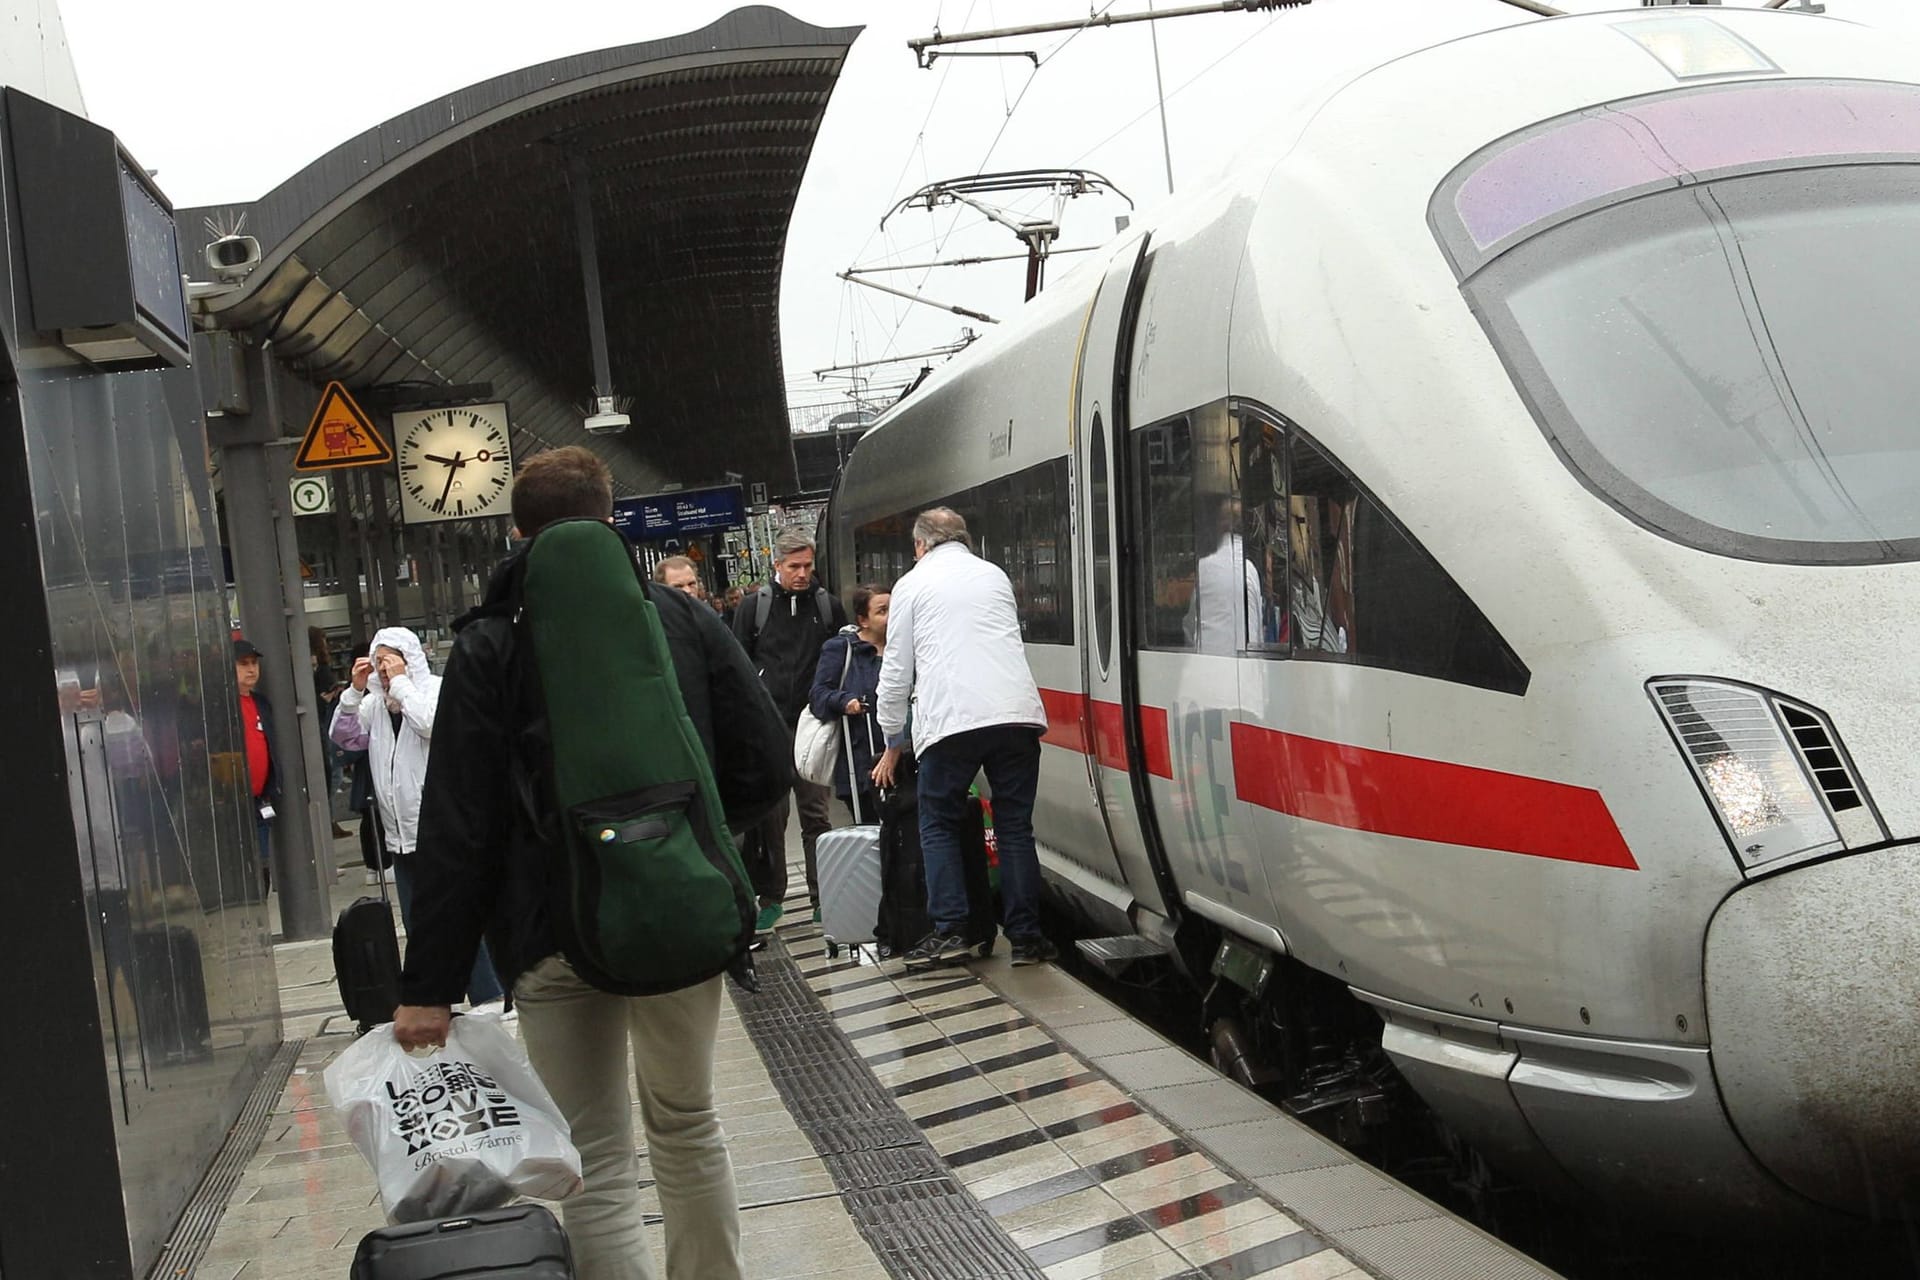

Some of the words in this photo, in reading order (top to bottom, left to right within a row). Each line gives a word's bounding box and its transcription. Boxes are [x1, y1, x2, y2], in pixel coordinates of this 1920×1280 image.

[727, 559, 737, 574] H
[1173, 701, 1250, 896] ICE
[414, 1140, 468, 1171] Bristol
[469, 1135, 523, 1151] Farms
